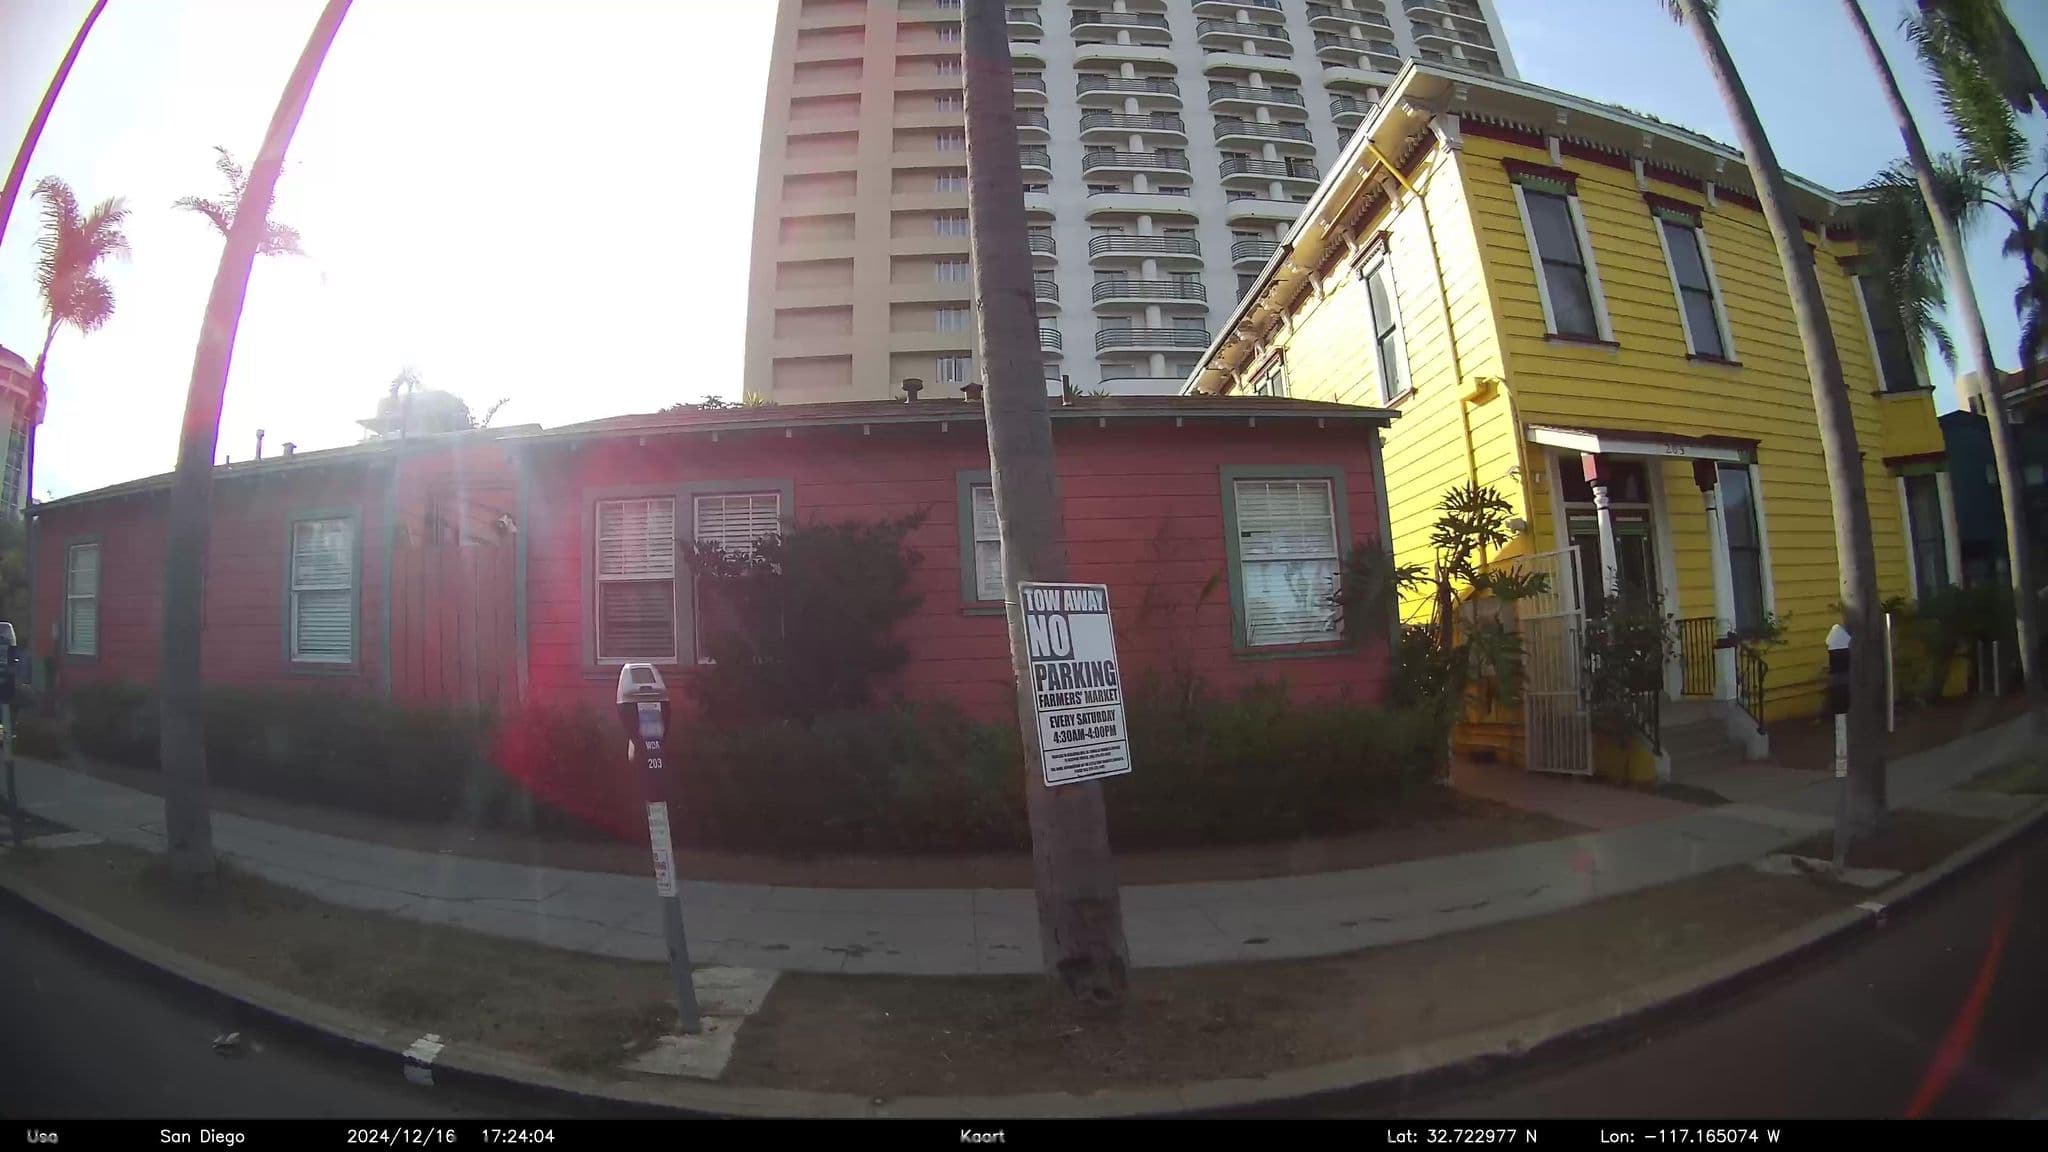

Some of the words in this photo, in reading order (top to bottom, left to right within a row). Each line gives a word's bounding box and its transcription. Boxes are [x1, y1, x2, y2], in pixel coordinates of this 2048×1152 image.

[1023, 588, 1060, 611] TOW
[1063, 588, 1105, 611] AWAY
[1026, 613, 1071, 657] NO
[1034, 660, 1117, 692] PARKING
[1083, 688, 1118, 705] MARKET
[1049, 713, 1076, 729] EVERY
[1076, 709, 1116, 726] SATURDAY
[1053, 724, 1118, 743] 4:30AM-4:00PM
[647, 758, 663, 769] 203
